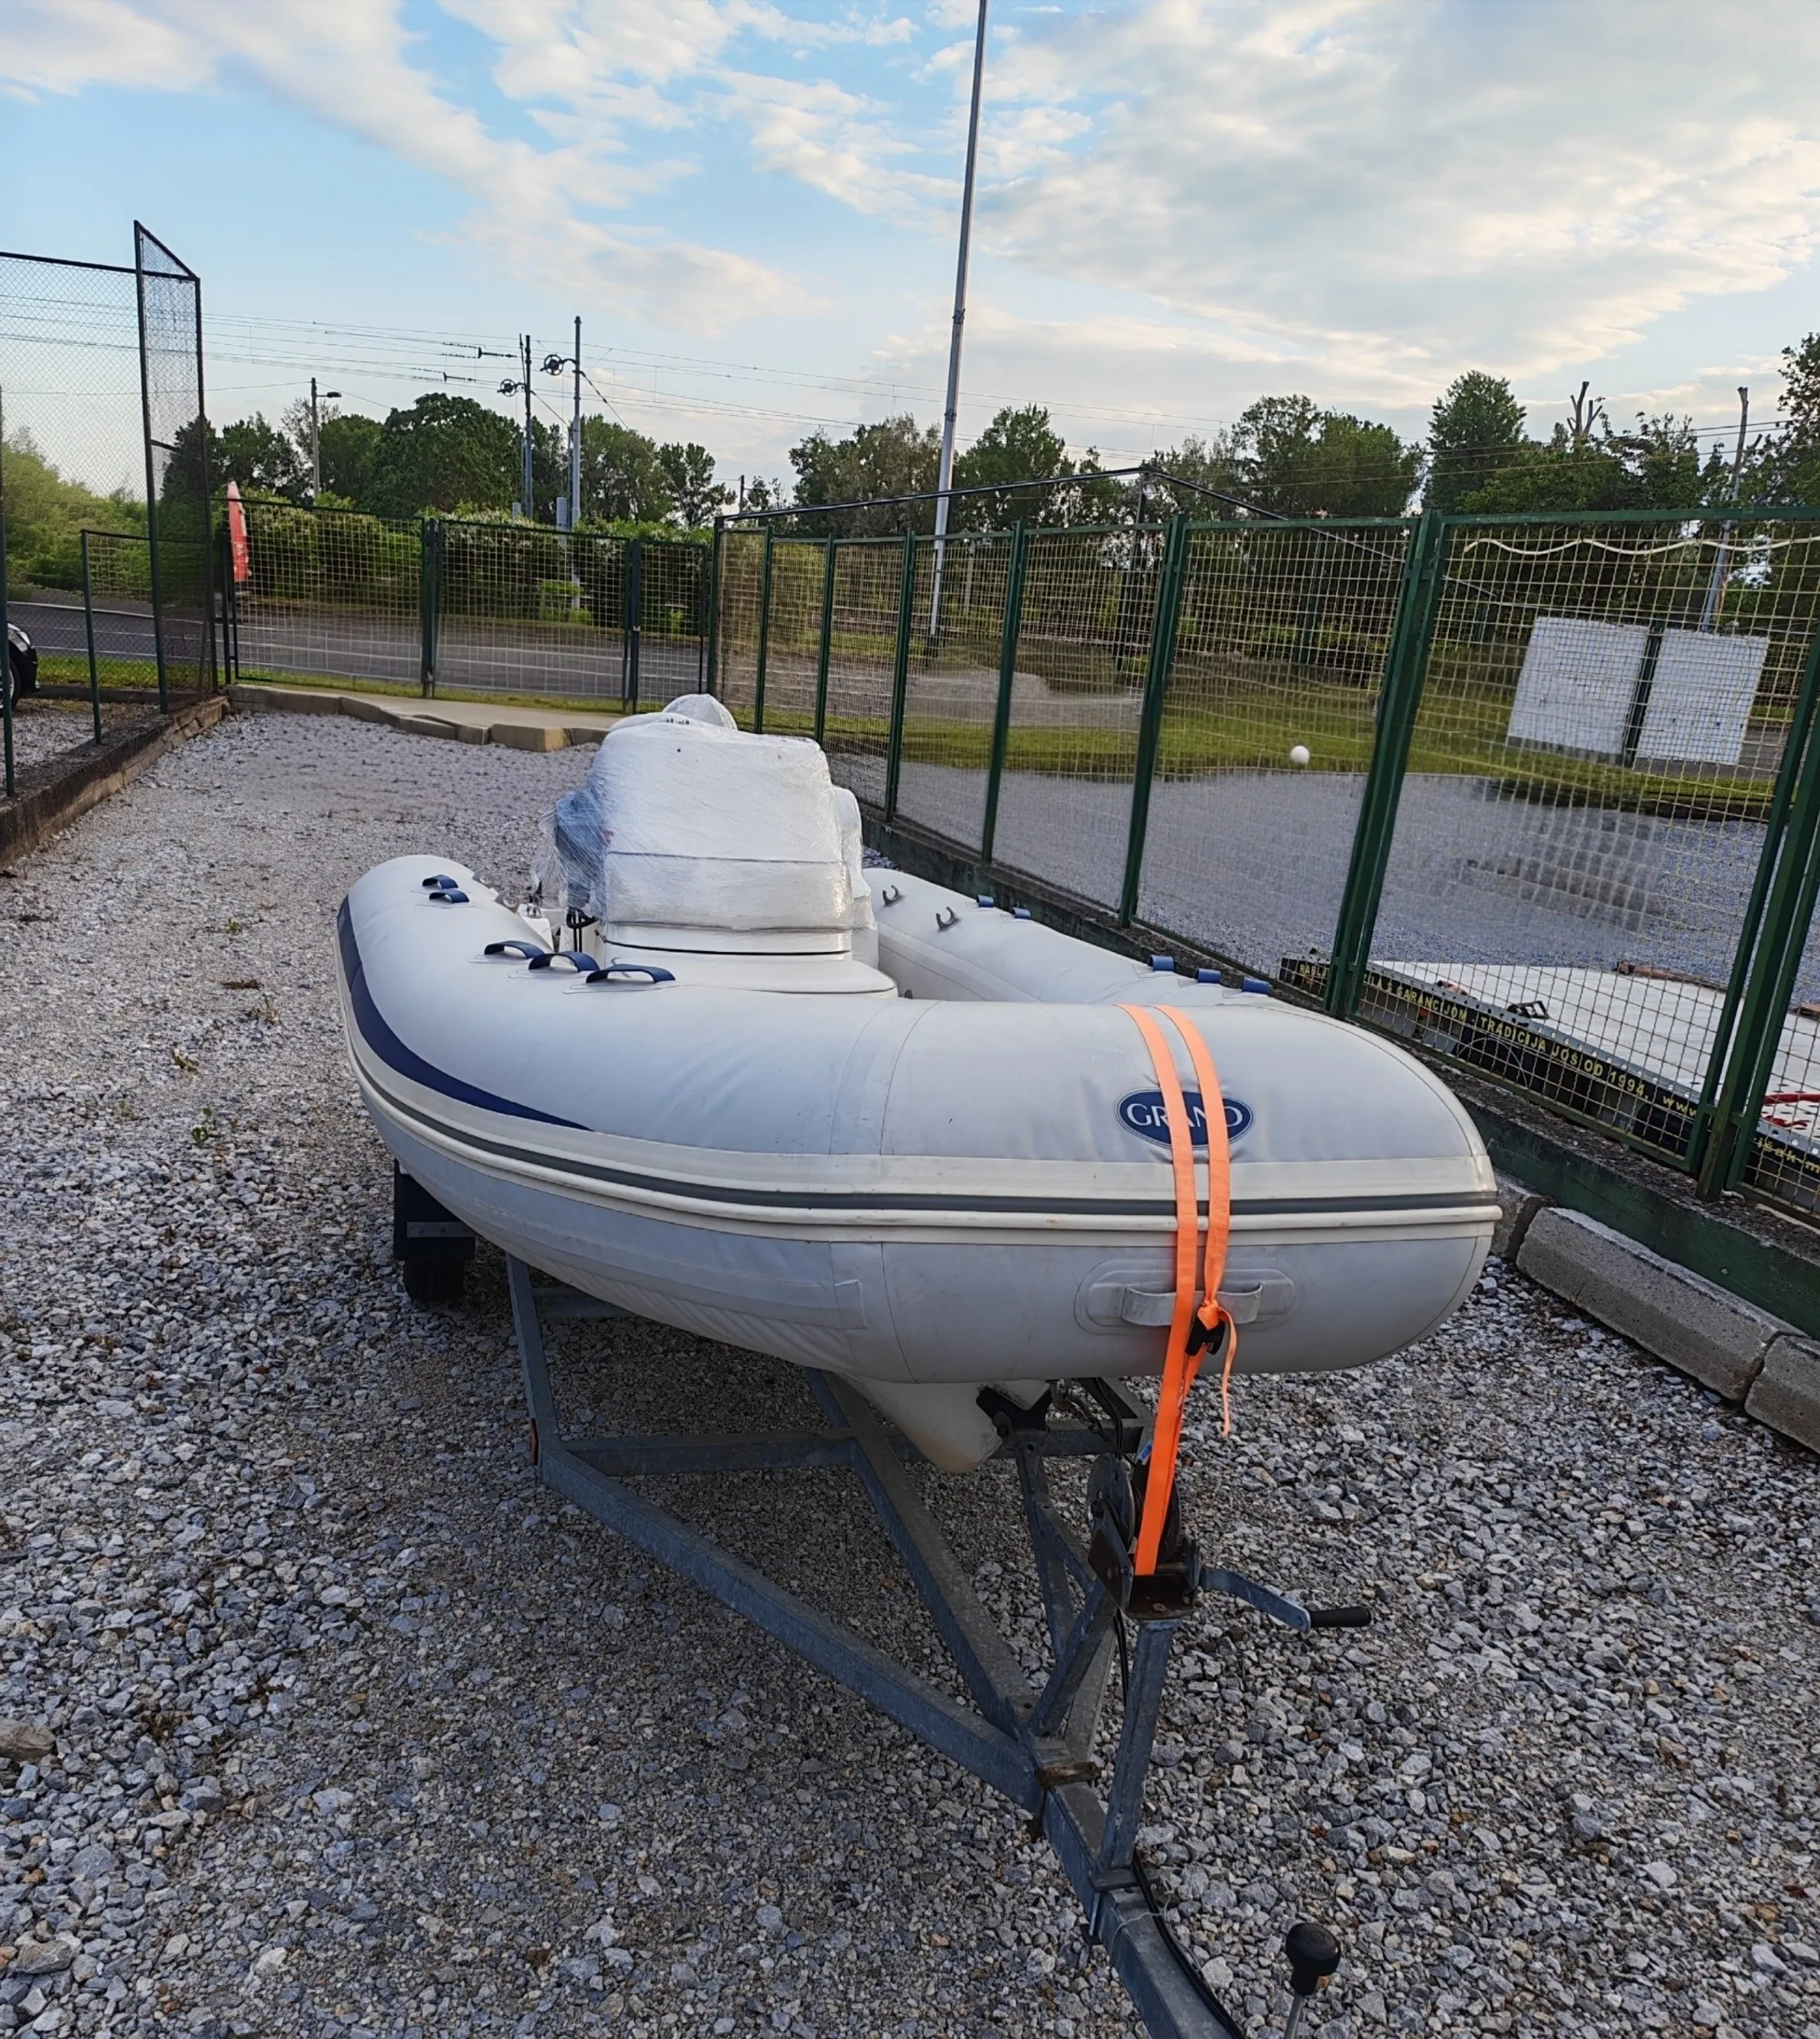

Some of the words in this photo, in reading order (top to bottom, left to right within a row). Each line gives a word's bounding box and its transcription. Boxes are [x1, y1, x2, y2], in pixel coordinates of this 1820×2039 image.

[1396, 984, 1468, 1021] GARANCIJOM
[1480, 1017, 1547, 1053] TRADICIJA
[1584, 1059, 1604, 1077] OD
[1610, 1071, 1650, 1100] 1994.
